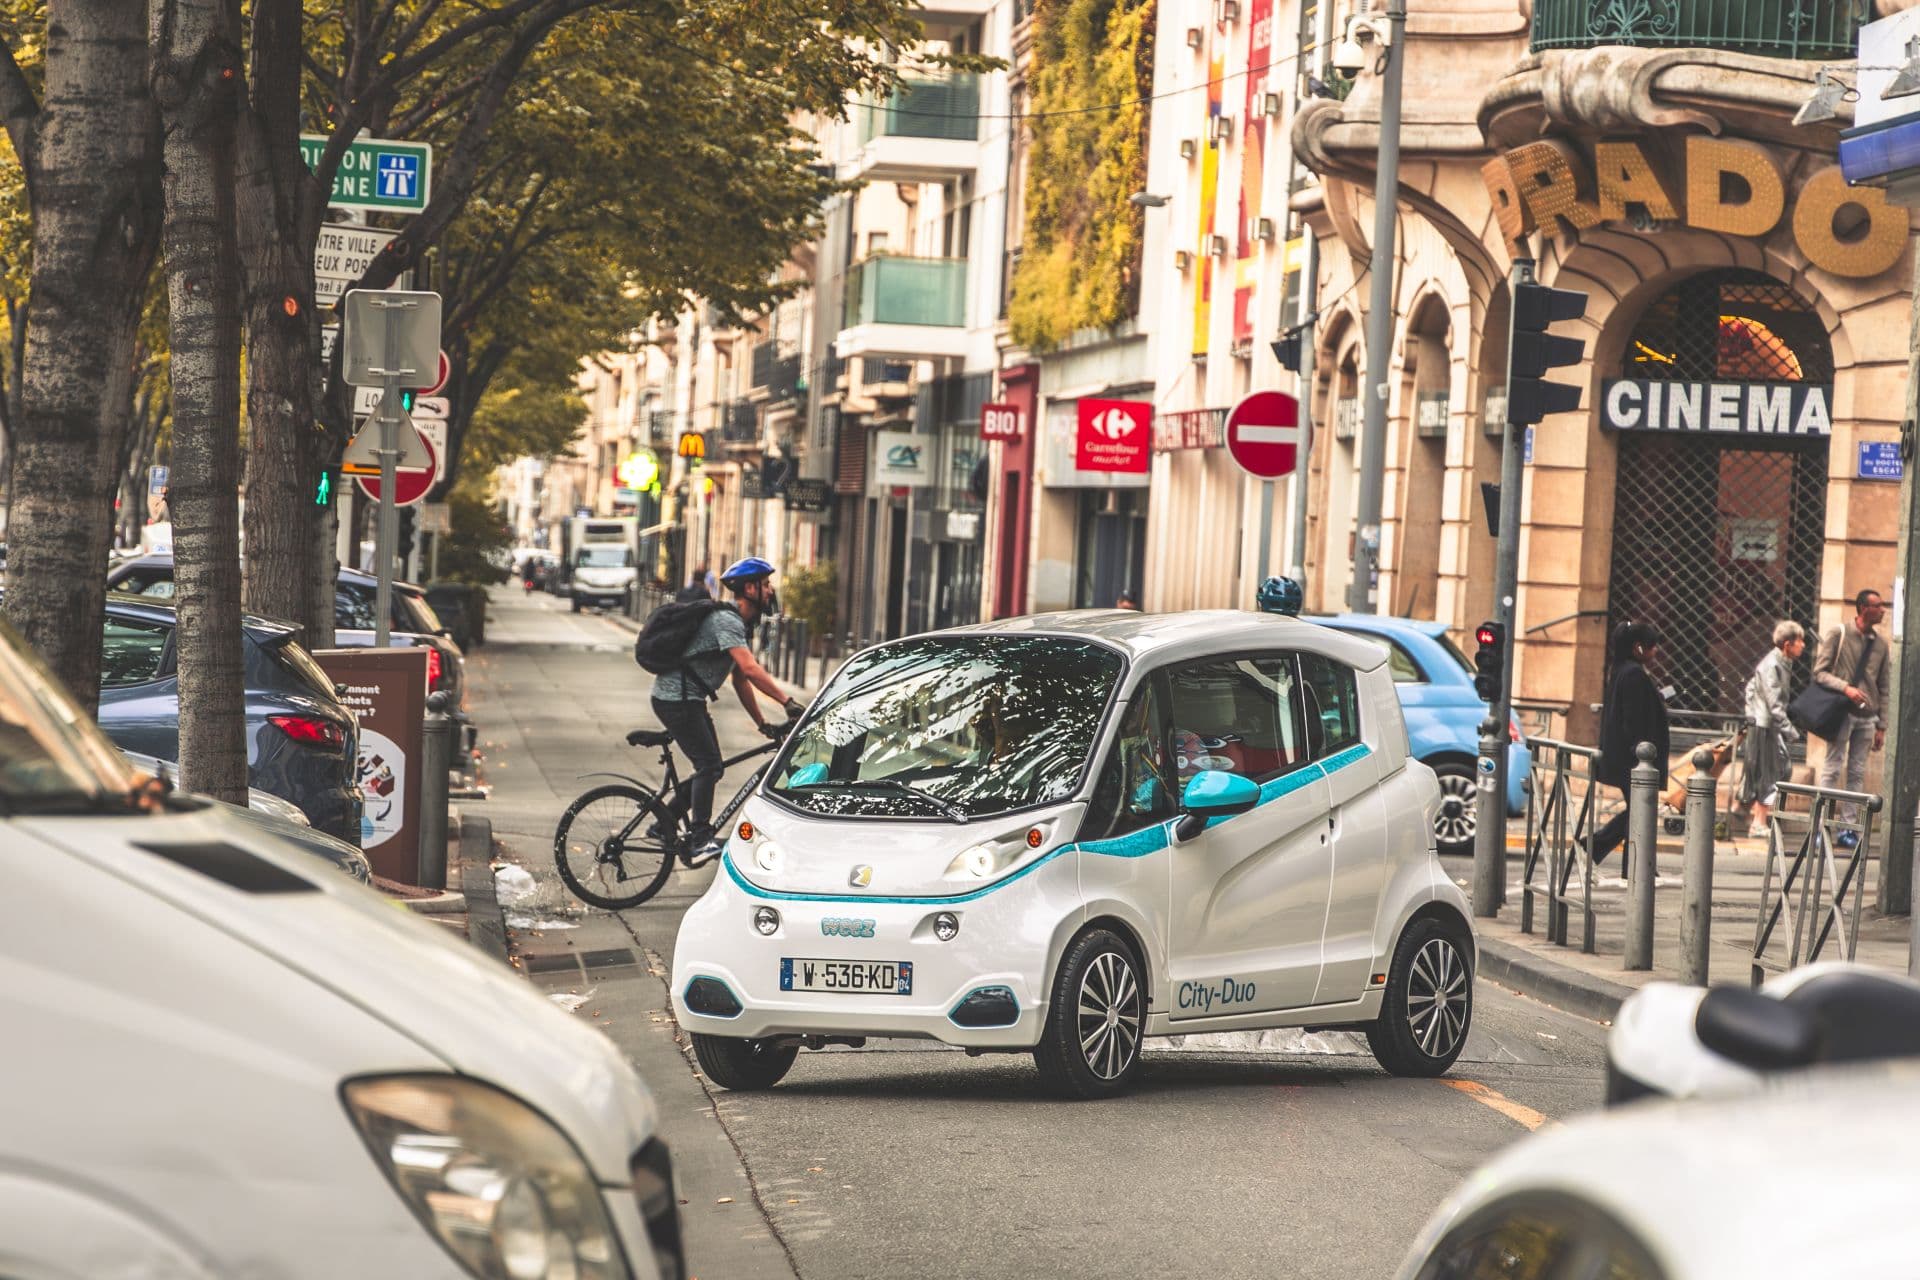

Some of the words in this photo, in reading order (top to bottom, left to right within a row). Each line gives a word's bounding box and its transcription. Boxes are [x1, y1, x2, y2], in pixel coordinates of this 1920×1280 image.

[1481, 134, 1911, 279] PRADO
[348, 237, 377, 254] VILLE
[984, 410, 1015, 434] BIO
[1607, 380, 1832, 435] CINEMA
[1085, 441, 1139, 455] Carrefour
[1178, 977, 1256, 1012] City-Duo
